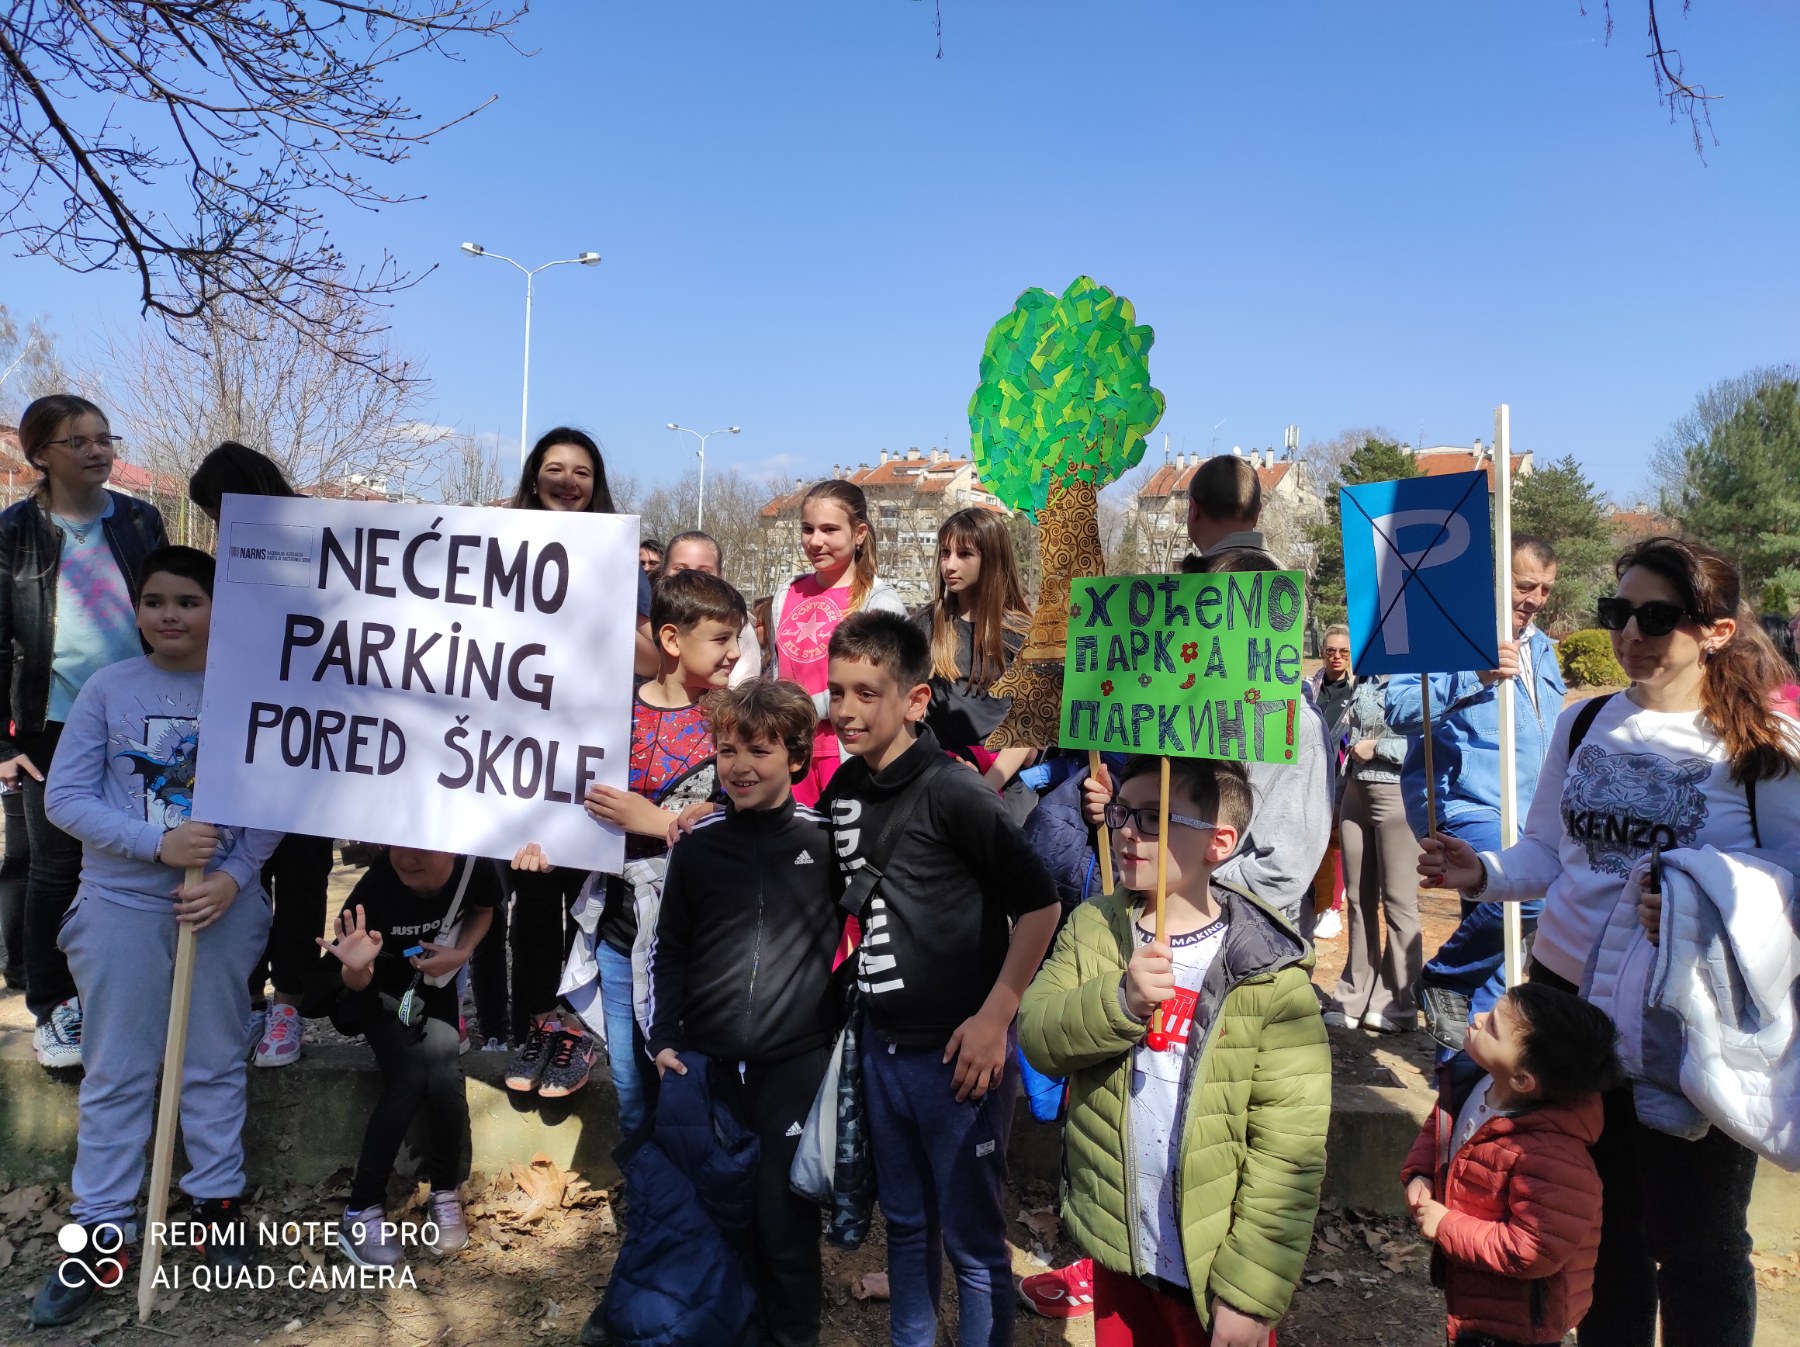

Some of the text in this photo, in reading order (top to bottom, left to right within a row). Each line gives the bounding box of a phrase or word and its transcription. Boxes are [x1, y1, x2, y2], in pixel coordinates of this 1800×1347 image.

[239, 547, 267, 560] NARNS
[317, 516, 570, 614] NEĆEMO
[1372, 509, 1471, 655] P
[1203, 635, 1228, 679] А
[244, 701, 606, 805] PORED ŠKOLE
[1568, 808, 1676, 853] KENZO
[390, 919, 441, 935] JUST DO
[1171, 921, 1224, 946] MAKING
